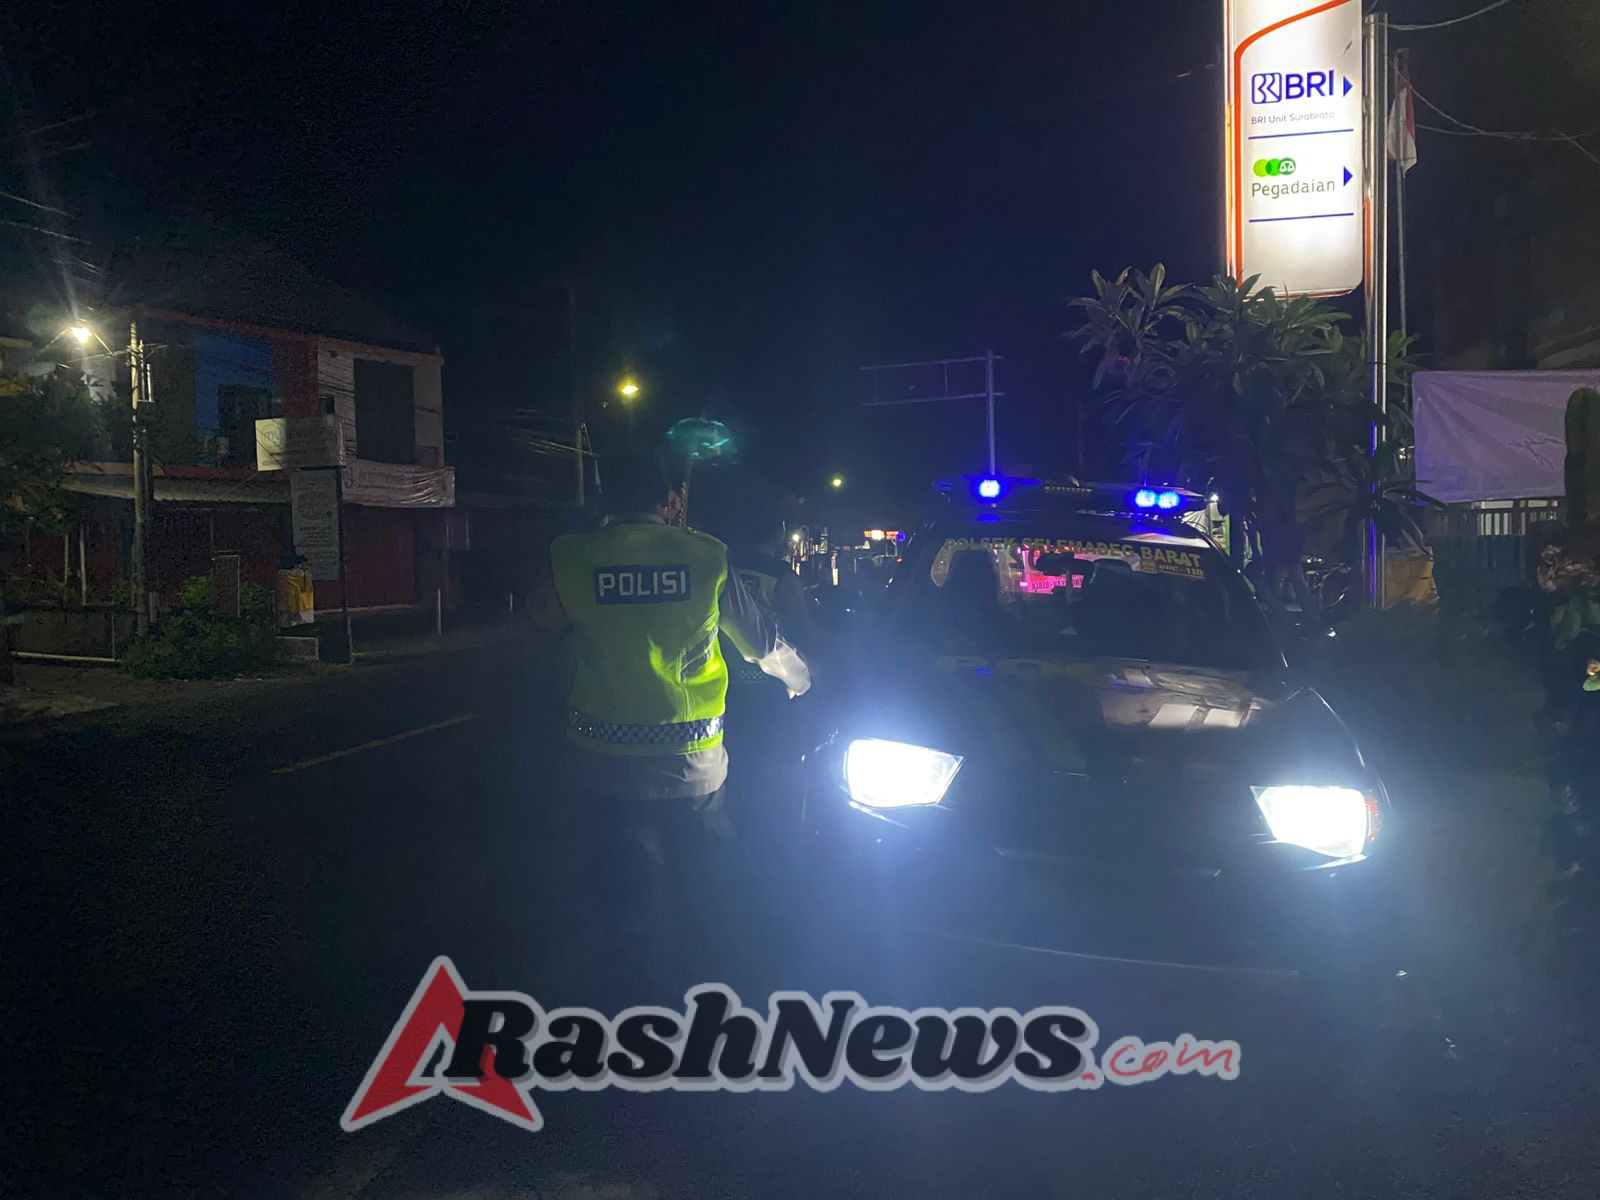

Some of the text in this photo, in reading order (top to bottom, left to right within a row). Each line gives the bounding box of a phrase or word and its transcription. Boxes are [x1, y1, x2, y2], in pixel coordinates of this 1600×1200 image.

[1285, 69, 1334, 99] BRI
[1251, 115, 1267, 125] BRI
[1269, 114, 1287, 124] Unit
[1251, 179, 1335, 199] Pegadaian
[1140, 546, 1201, 567] BARAT
[598, 570, 686, 597] POLISI
